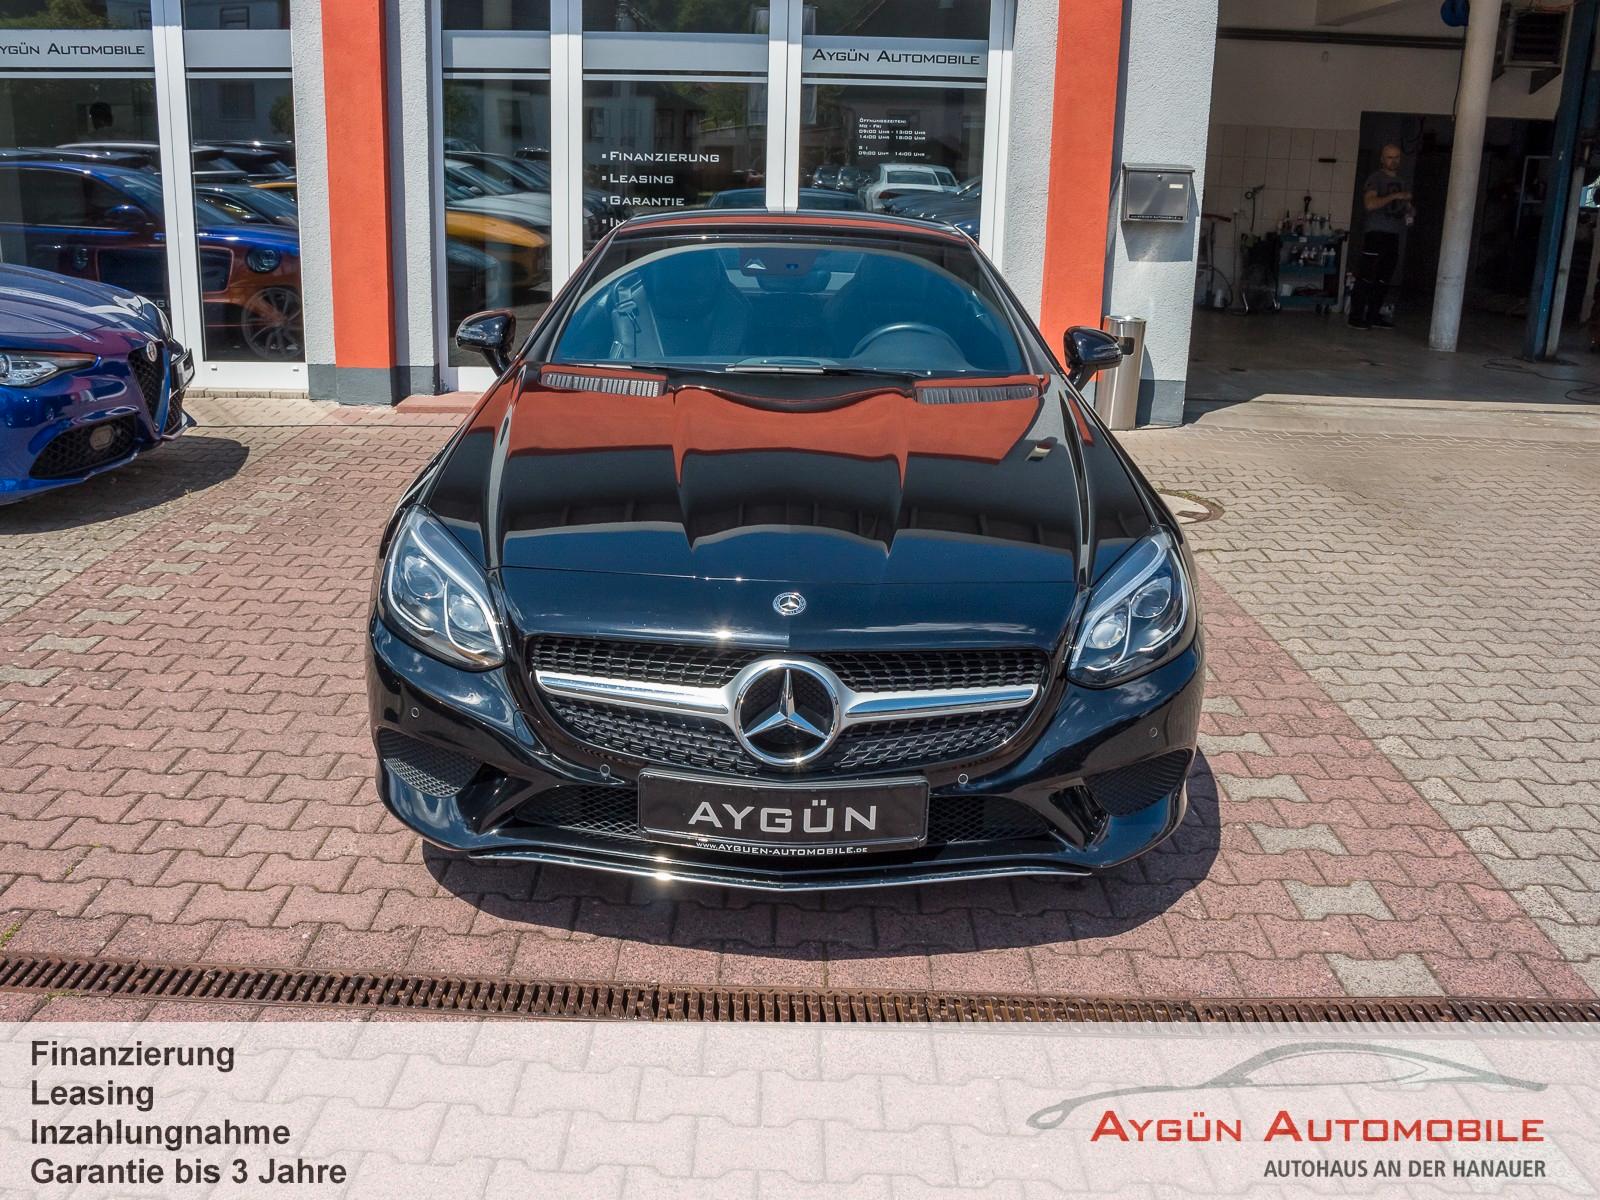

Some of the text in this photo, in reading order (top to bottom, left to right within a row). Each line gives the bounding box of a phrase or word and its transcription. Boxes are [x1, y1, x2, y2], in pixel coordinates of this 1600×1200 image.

[0, 42, 145, 55] YGÜN AUTOMOBILE
[812, 49, 980, 65] AYGÜN AUTOMOBILE
[609, 151, 720, 163] FINANZIERUNG
[609, 173, 674, 184] LEASING
[609, 195, 685, 206] GARANTIE
[688, 799, 878, 834] AYGÜN
